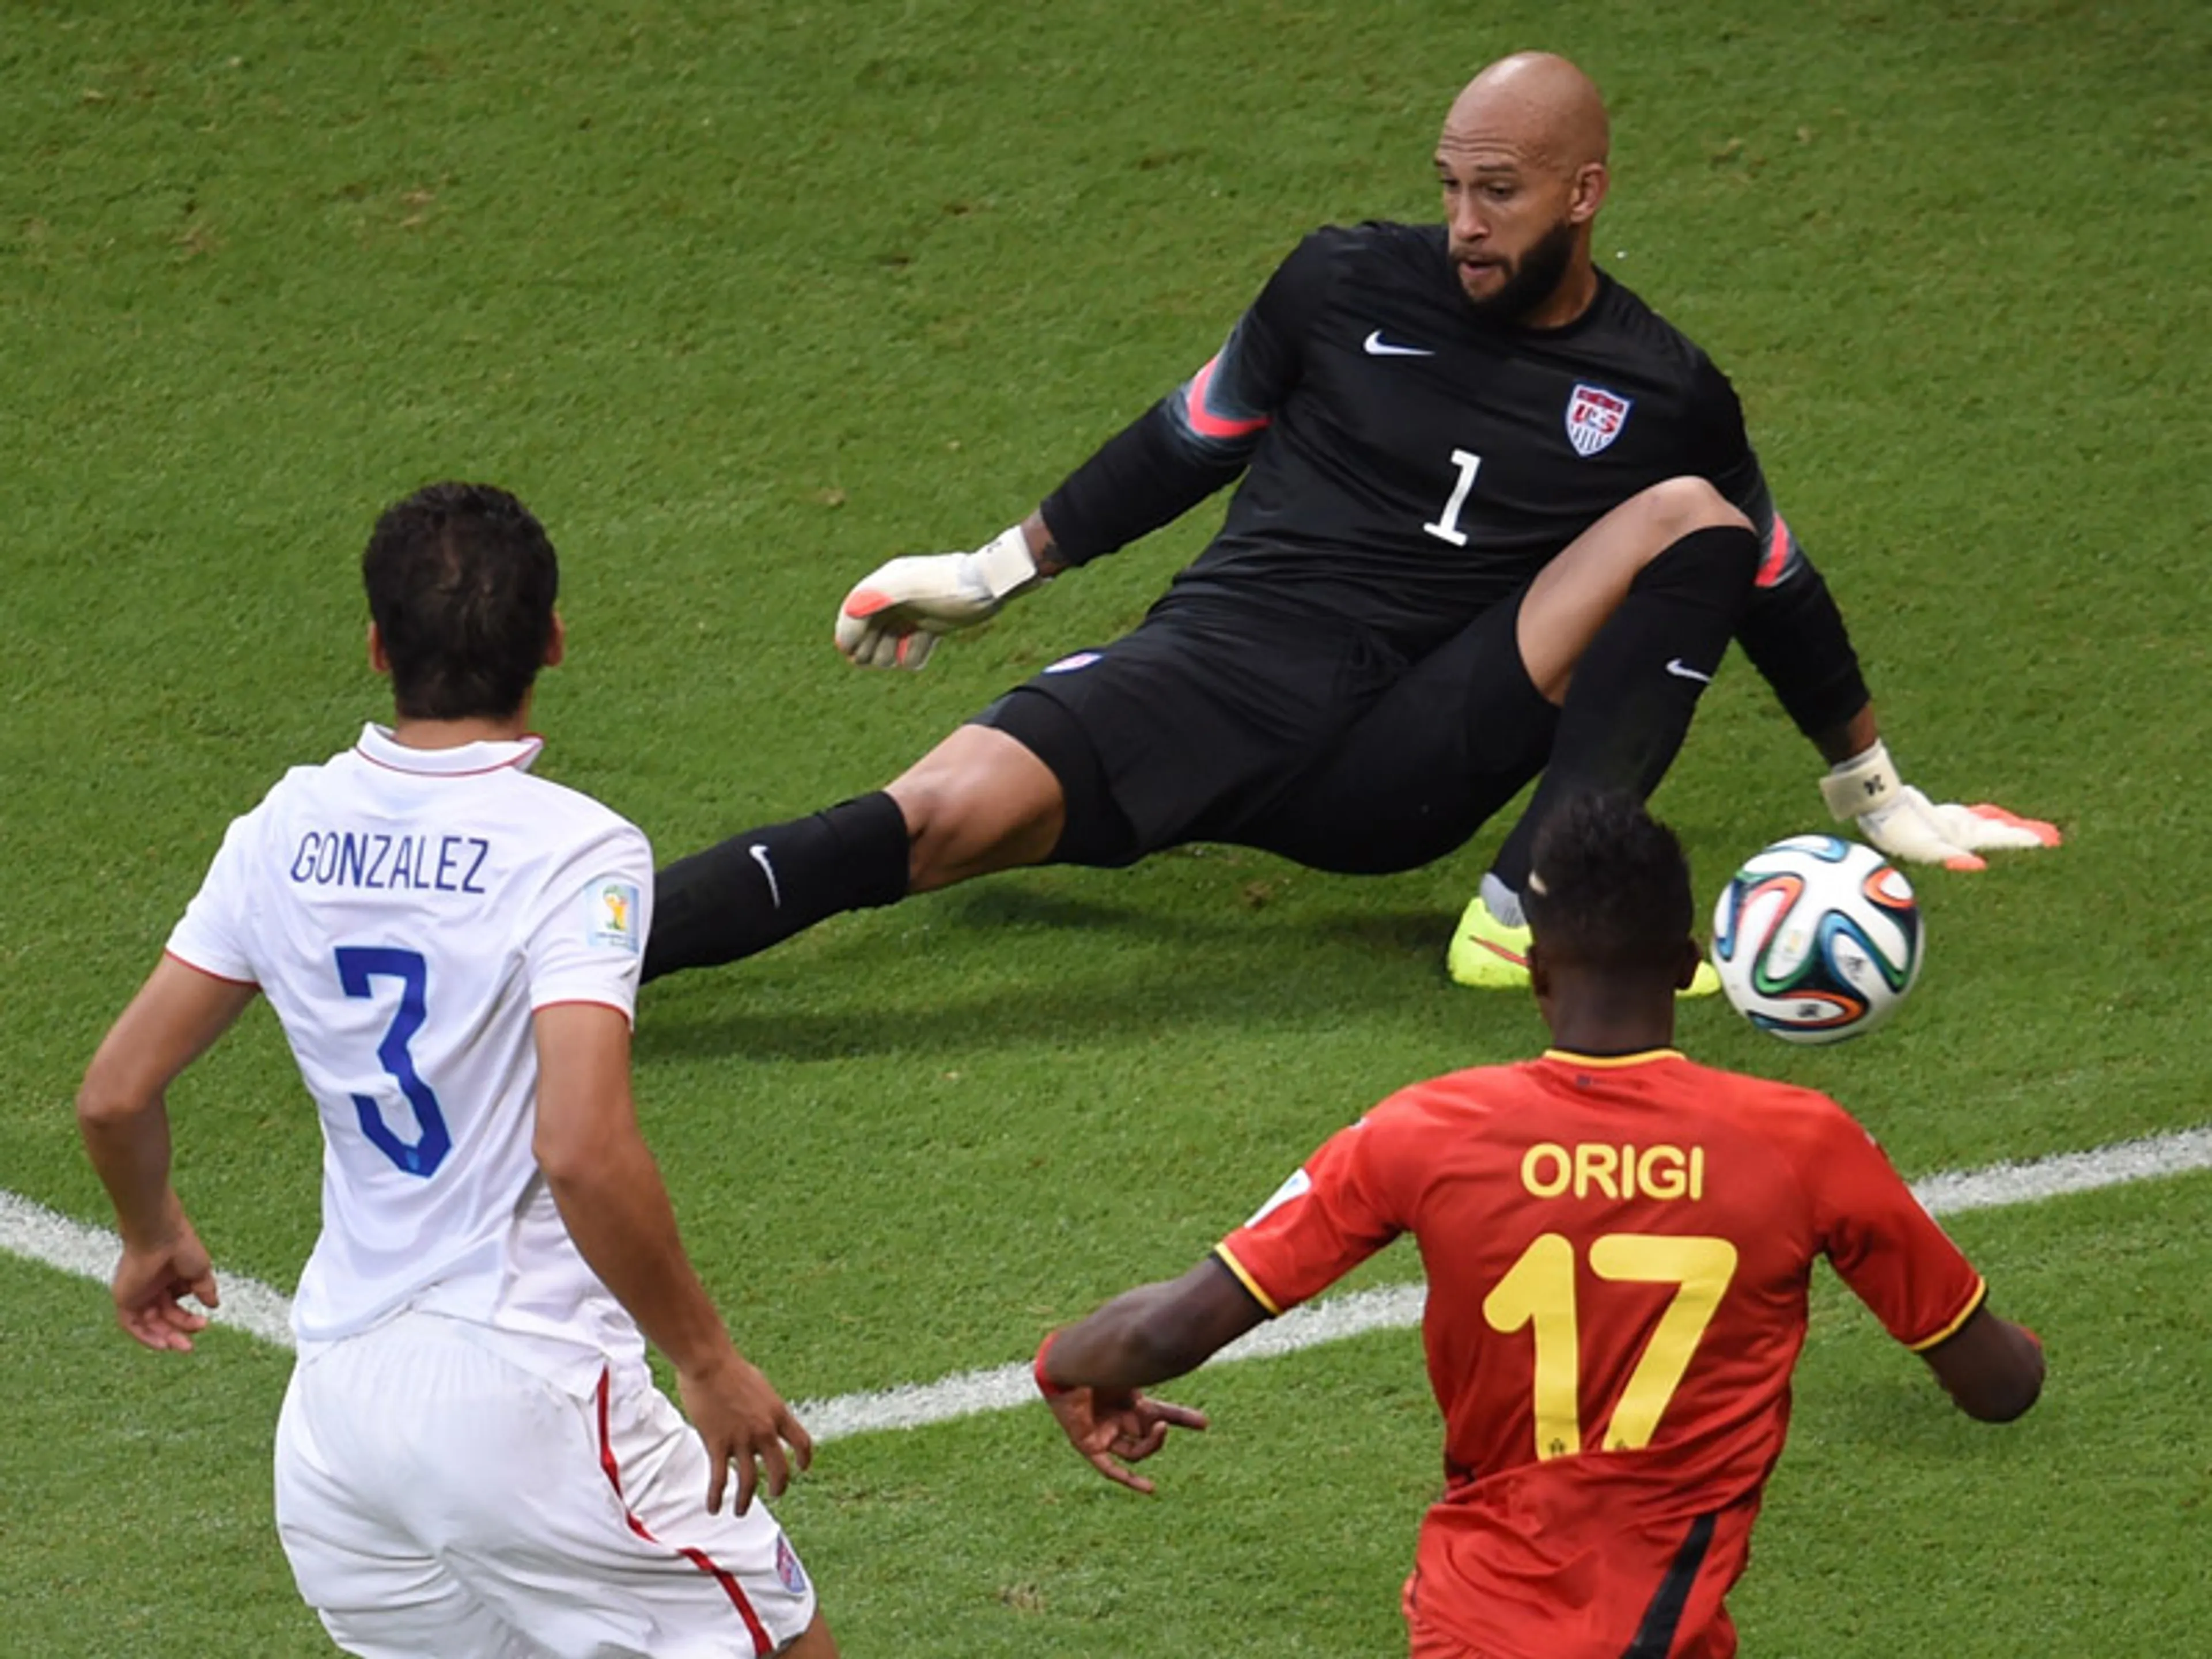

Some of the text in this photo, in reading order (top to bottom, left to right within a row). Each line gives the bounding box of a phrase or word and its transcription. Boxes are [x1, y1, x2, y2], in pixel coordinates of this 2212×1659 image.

[1423, 448, 1481, 547] 1
[290, 831, 490, 894] GONZALEZ
[333, 945, 452, 1179] 3
[1520, 1142, 1705, 1200] ORIGI
[1482, 1232, 1738, 1462] 17
